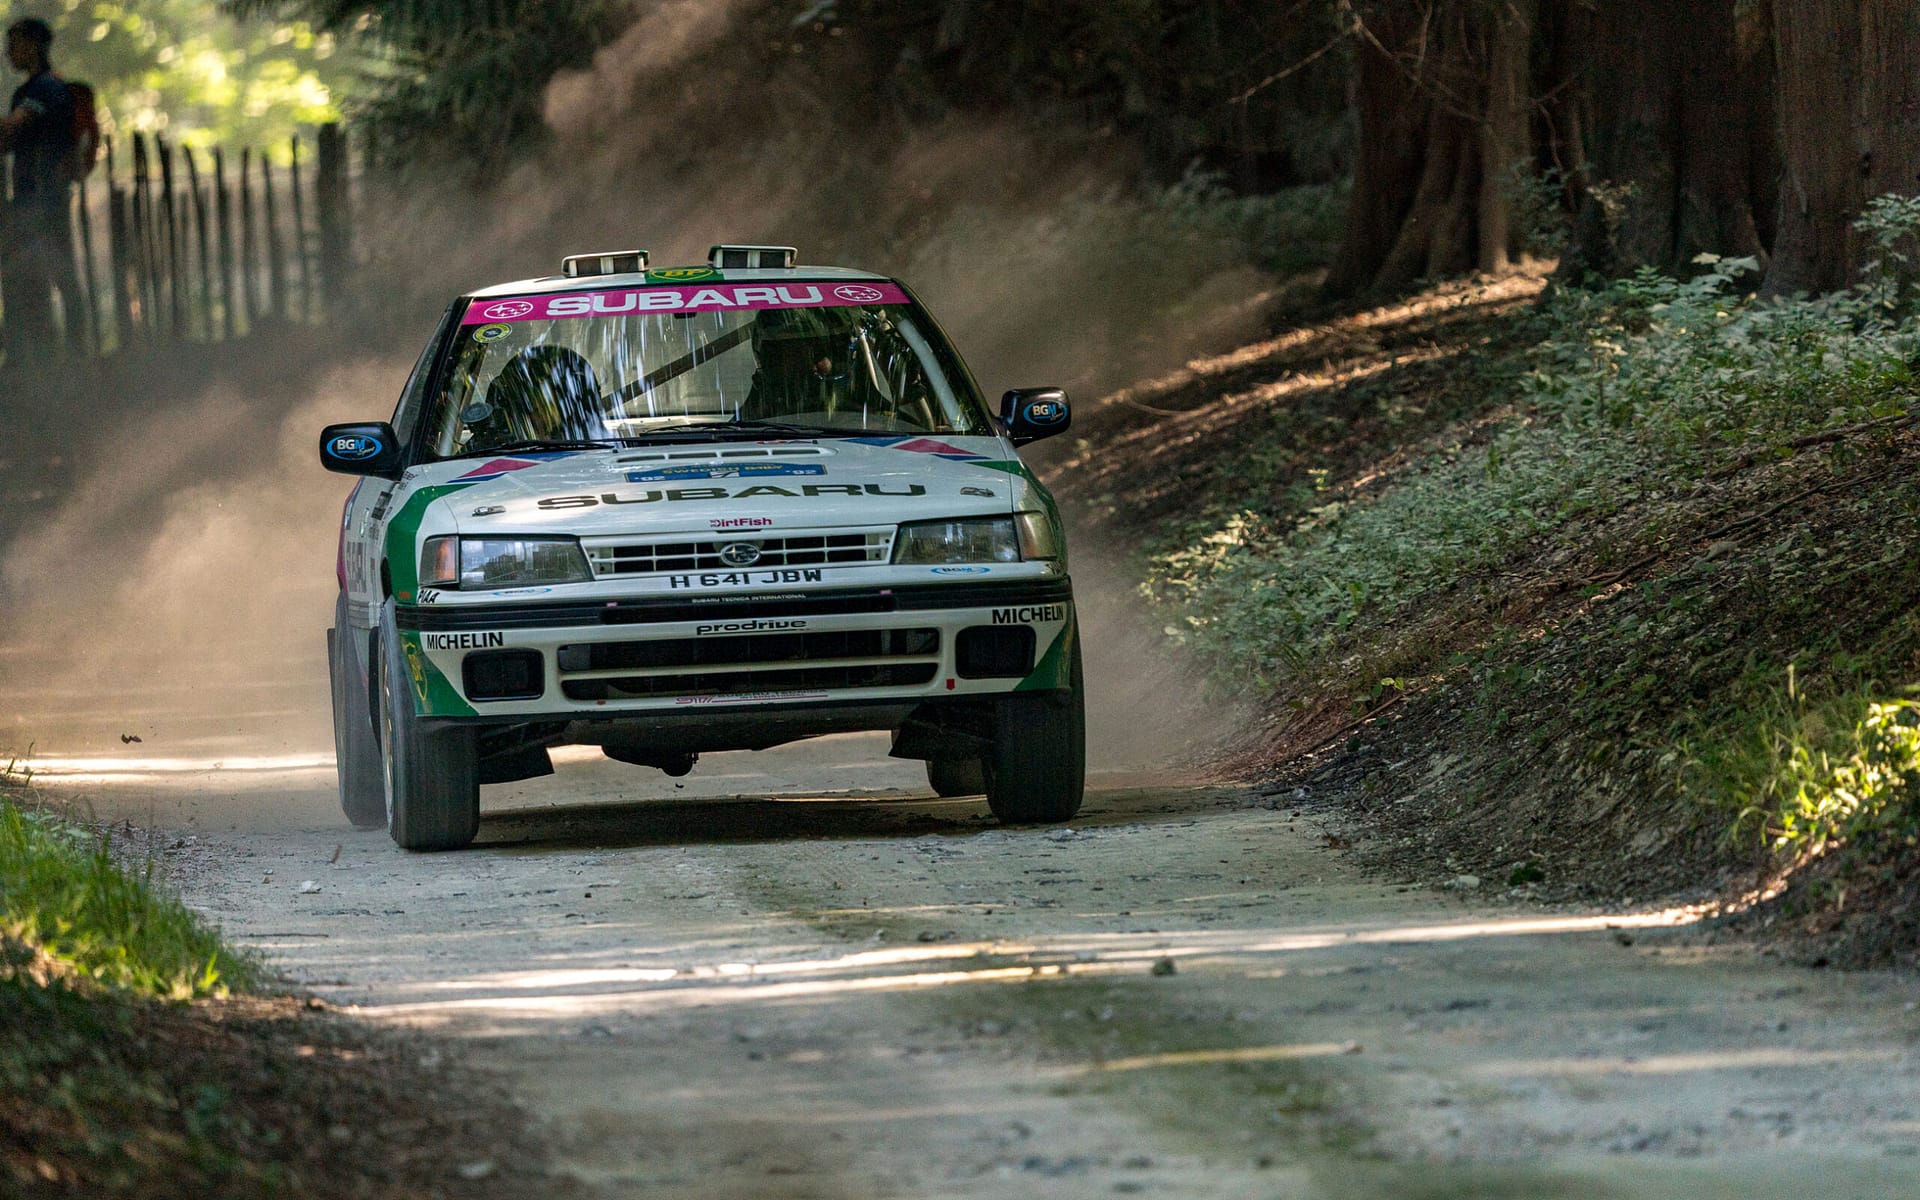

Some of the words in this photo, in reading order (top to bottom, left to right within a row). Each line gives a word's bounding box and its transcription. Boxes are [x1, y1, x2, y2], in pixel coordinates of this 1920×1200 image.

[546, 285, 823, 317] SUBARU
[1032, 403, 1057, 416] BGM
[336, 438, 366, 450] BGM
[538, 484, 926, 510] SUBARU
[709, 517, 772, 528] DirtFish
[670, 576, 691, 589] H
[700, 572, 750, 587] 641
[761, 569, 822, 584] JBW
[992, 605, 1065, 624] MICHELIN
[696, 619, 808, 636] prodrive
[426, 631, 504, 650] MICHELIN
